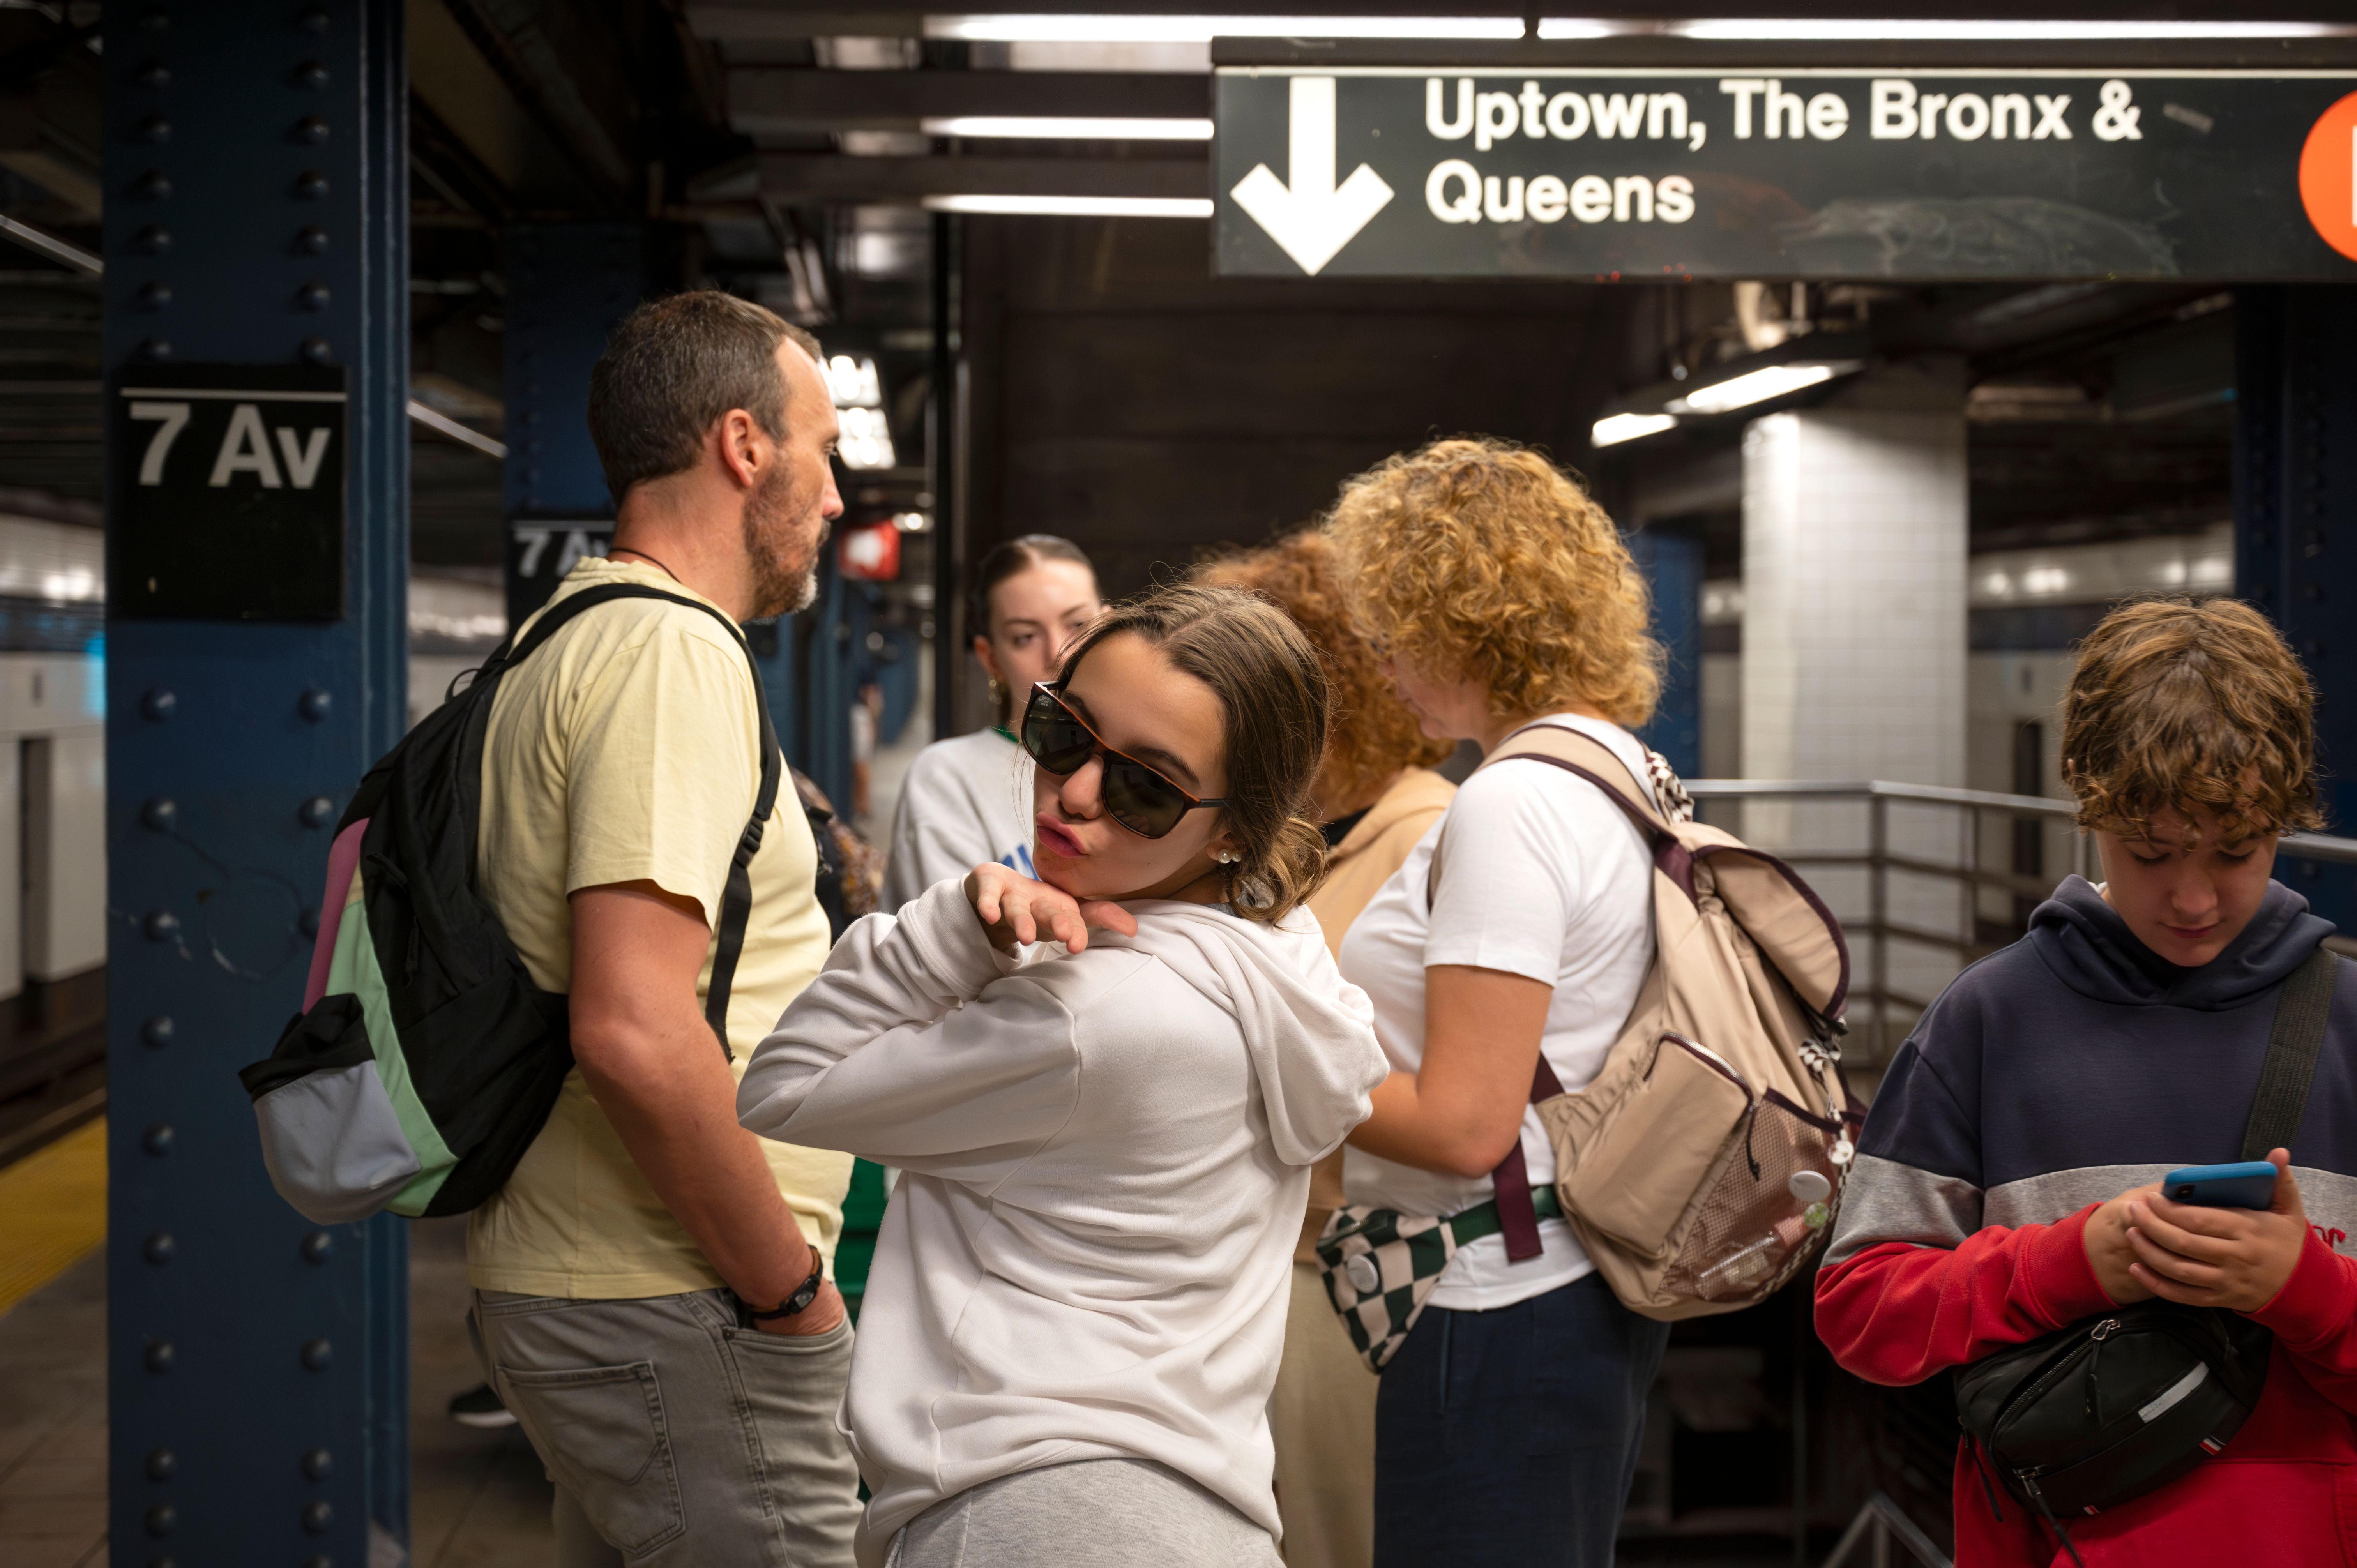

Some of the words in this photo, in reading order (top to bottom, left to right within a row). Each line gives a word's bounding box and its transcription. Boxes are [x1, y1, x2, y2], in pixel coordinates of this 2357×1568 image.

[1425, 77, 1707, 152] Uptown,
[1718, 78, 1850, 141] The
[1869, 78, 2073, 141] Bronx
[2091, 79, 2144, 141] &
[1425, 159, 1696, 224] Queens
[129, 401, 192, 487] 7
[208, 403, 332, 489] Av
[513, 527, 551, 578] 7
